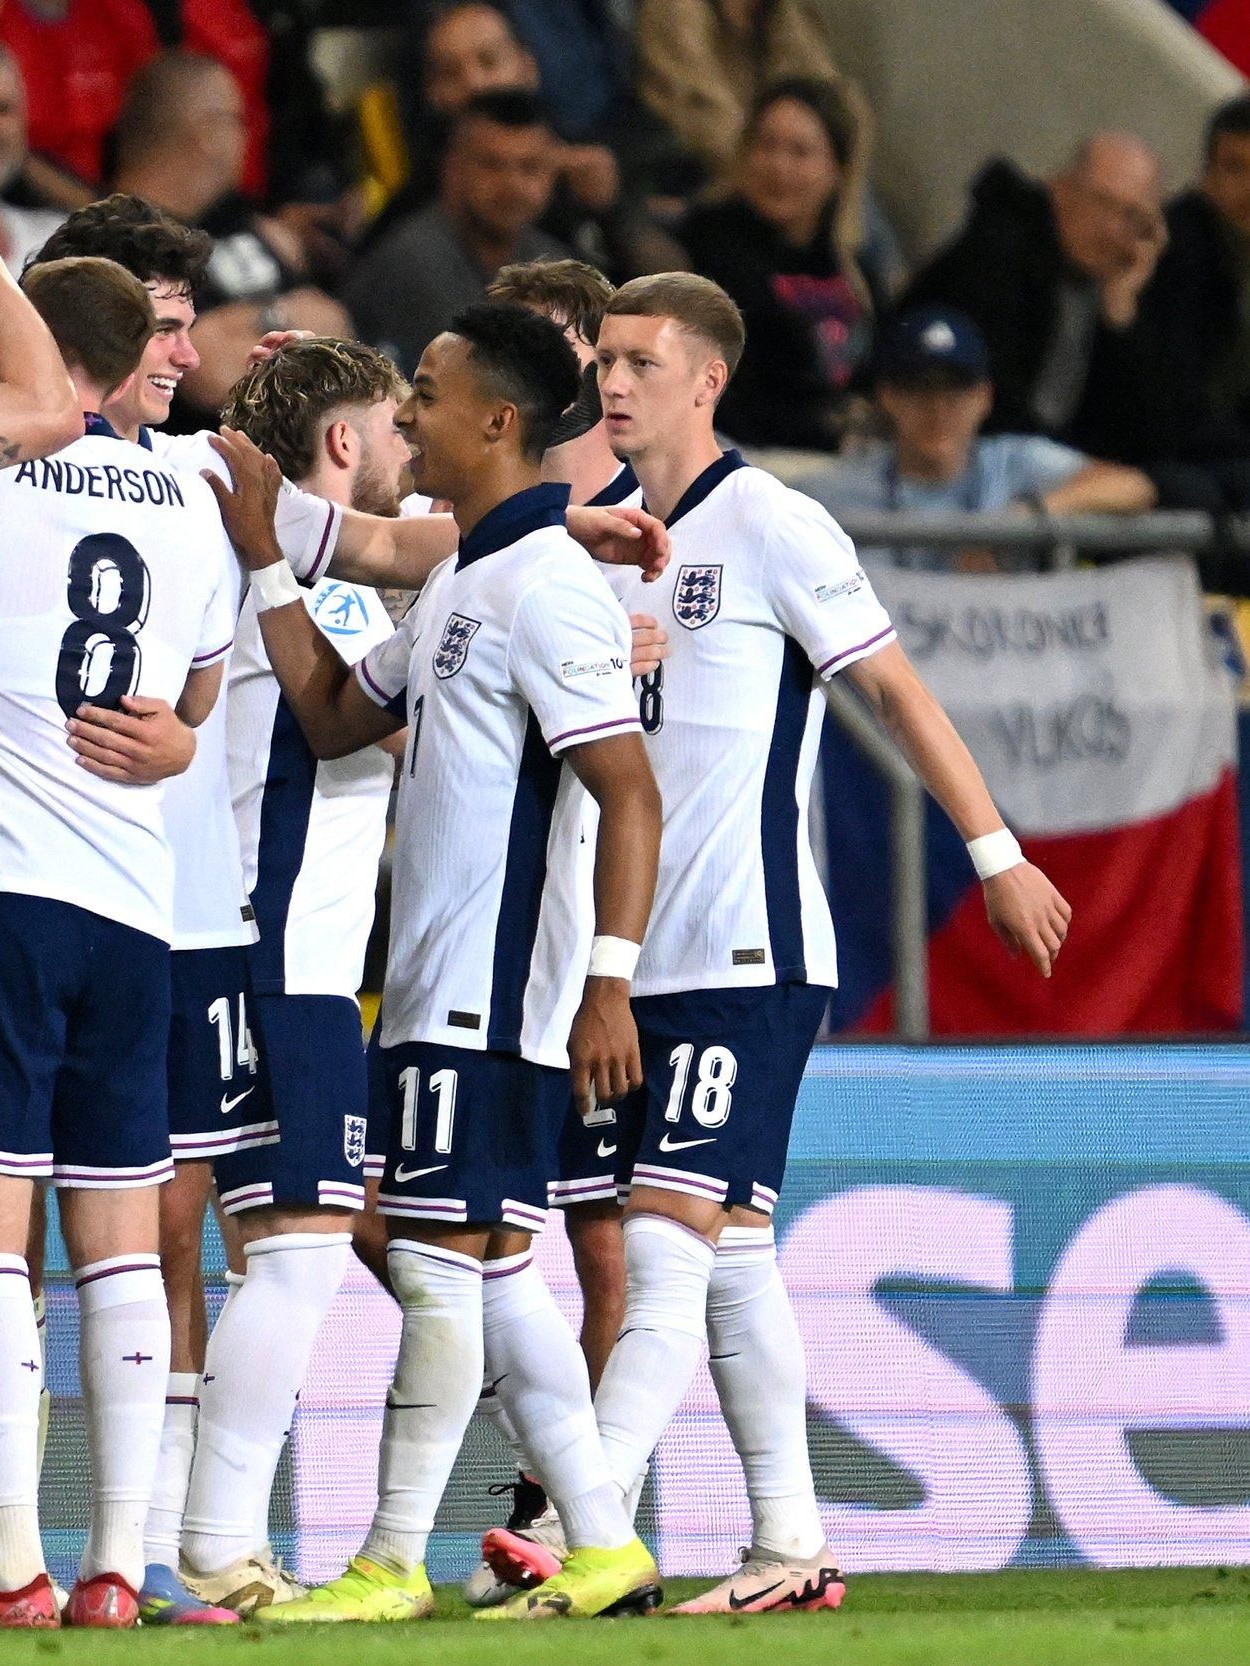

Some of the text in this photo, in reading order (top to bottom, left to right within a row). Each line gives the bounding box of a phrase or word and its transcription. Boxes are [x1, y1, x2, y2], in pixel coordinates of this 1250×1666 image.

[14, 458, 185, 508] ANDERSON
[55, 532, 151, 724] 8
[632, 659, 664, 735] 8
[207, 991, 258, 1080] 14
[397, 1066, 457, 1154] 11
[664, 1042, 737, 1128] 18
